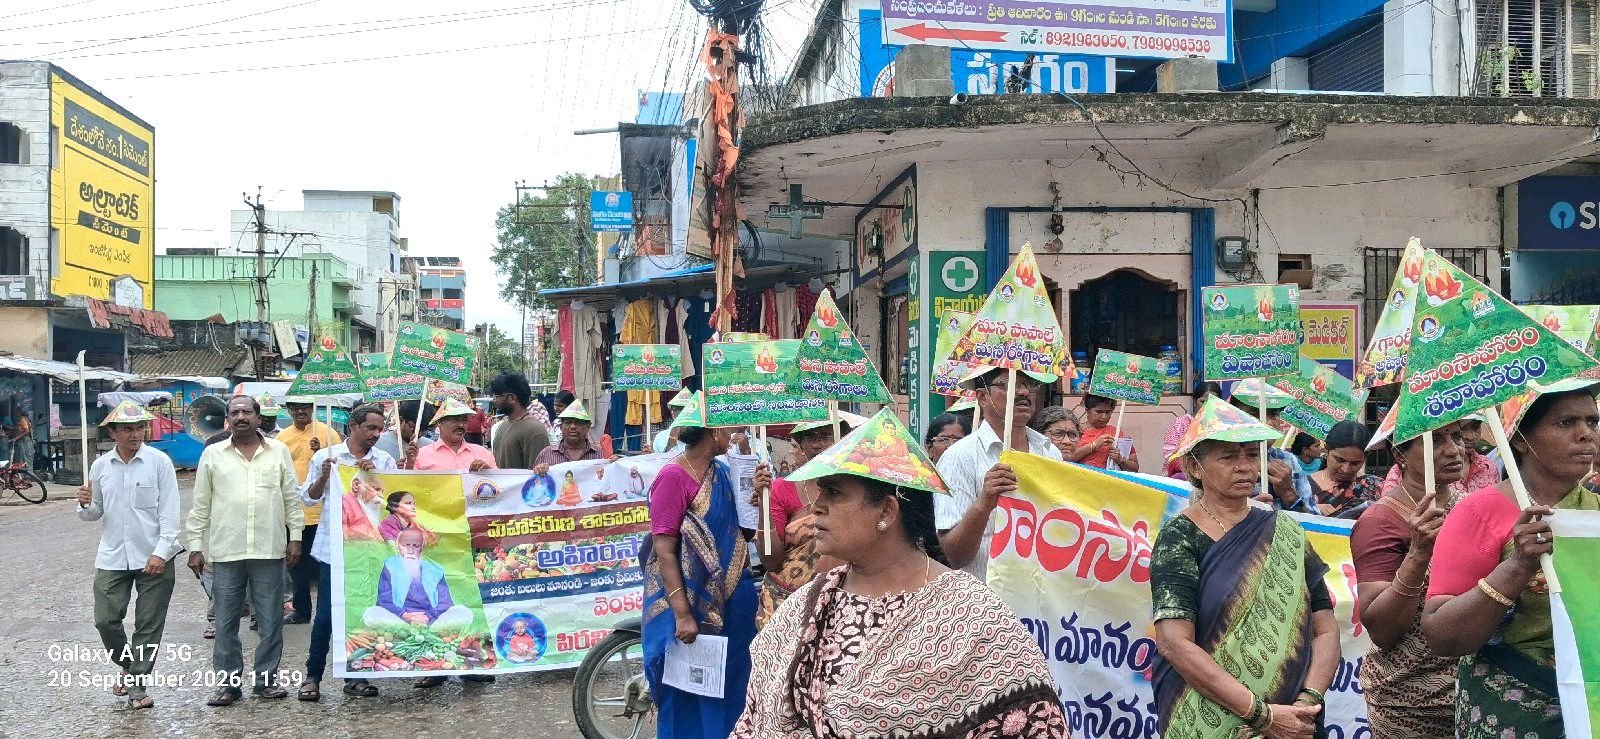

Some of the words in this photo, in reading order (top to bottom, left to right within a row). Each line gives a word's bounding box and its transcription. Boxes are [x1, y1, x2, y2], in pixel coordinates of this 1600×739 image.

[1008, 7, 1051, 20] ఆదివారం
[1191, 16, 1216, 29] వరకు
[977, 320, 1007, 335] మన
[1010, 322, 1056, 344] పాపాలే
[1214, 329, 1296, 350] మాంసాహారం
[1308, 317, 1350, 355] మెడికల్స్
[799, 359, 822, 374] మన
[823, 357, 868, 376] పాపాలే
[975, 343, 1007, 358] మన
[1006, 343, 1053, 367] రోగాలు
[1221, 350, 1293, 375] విషాహారం
[1407, 327, 1539, 395] మాంసాహారం
[801, 377, 823, 392] మన
[824, 379, 869, 396] రోగాలు
[1422, 355, 1547, 418] శవాహారం
[487, 516, 577, 538] మహాకరుణ
[579, 506, 652, 530] శాకాహా
